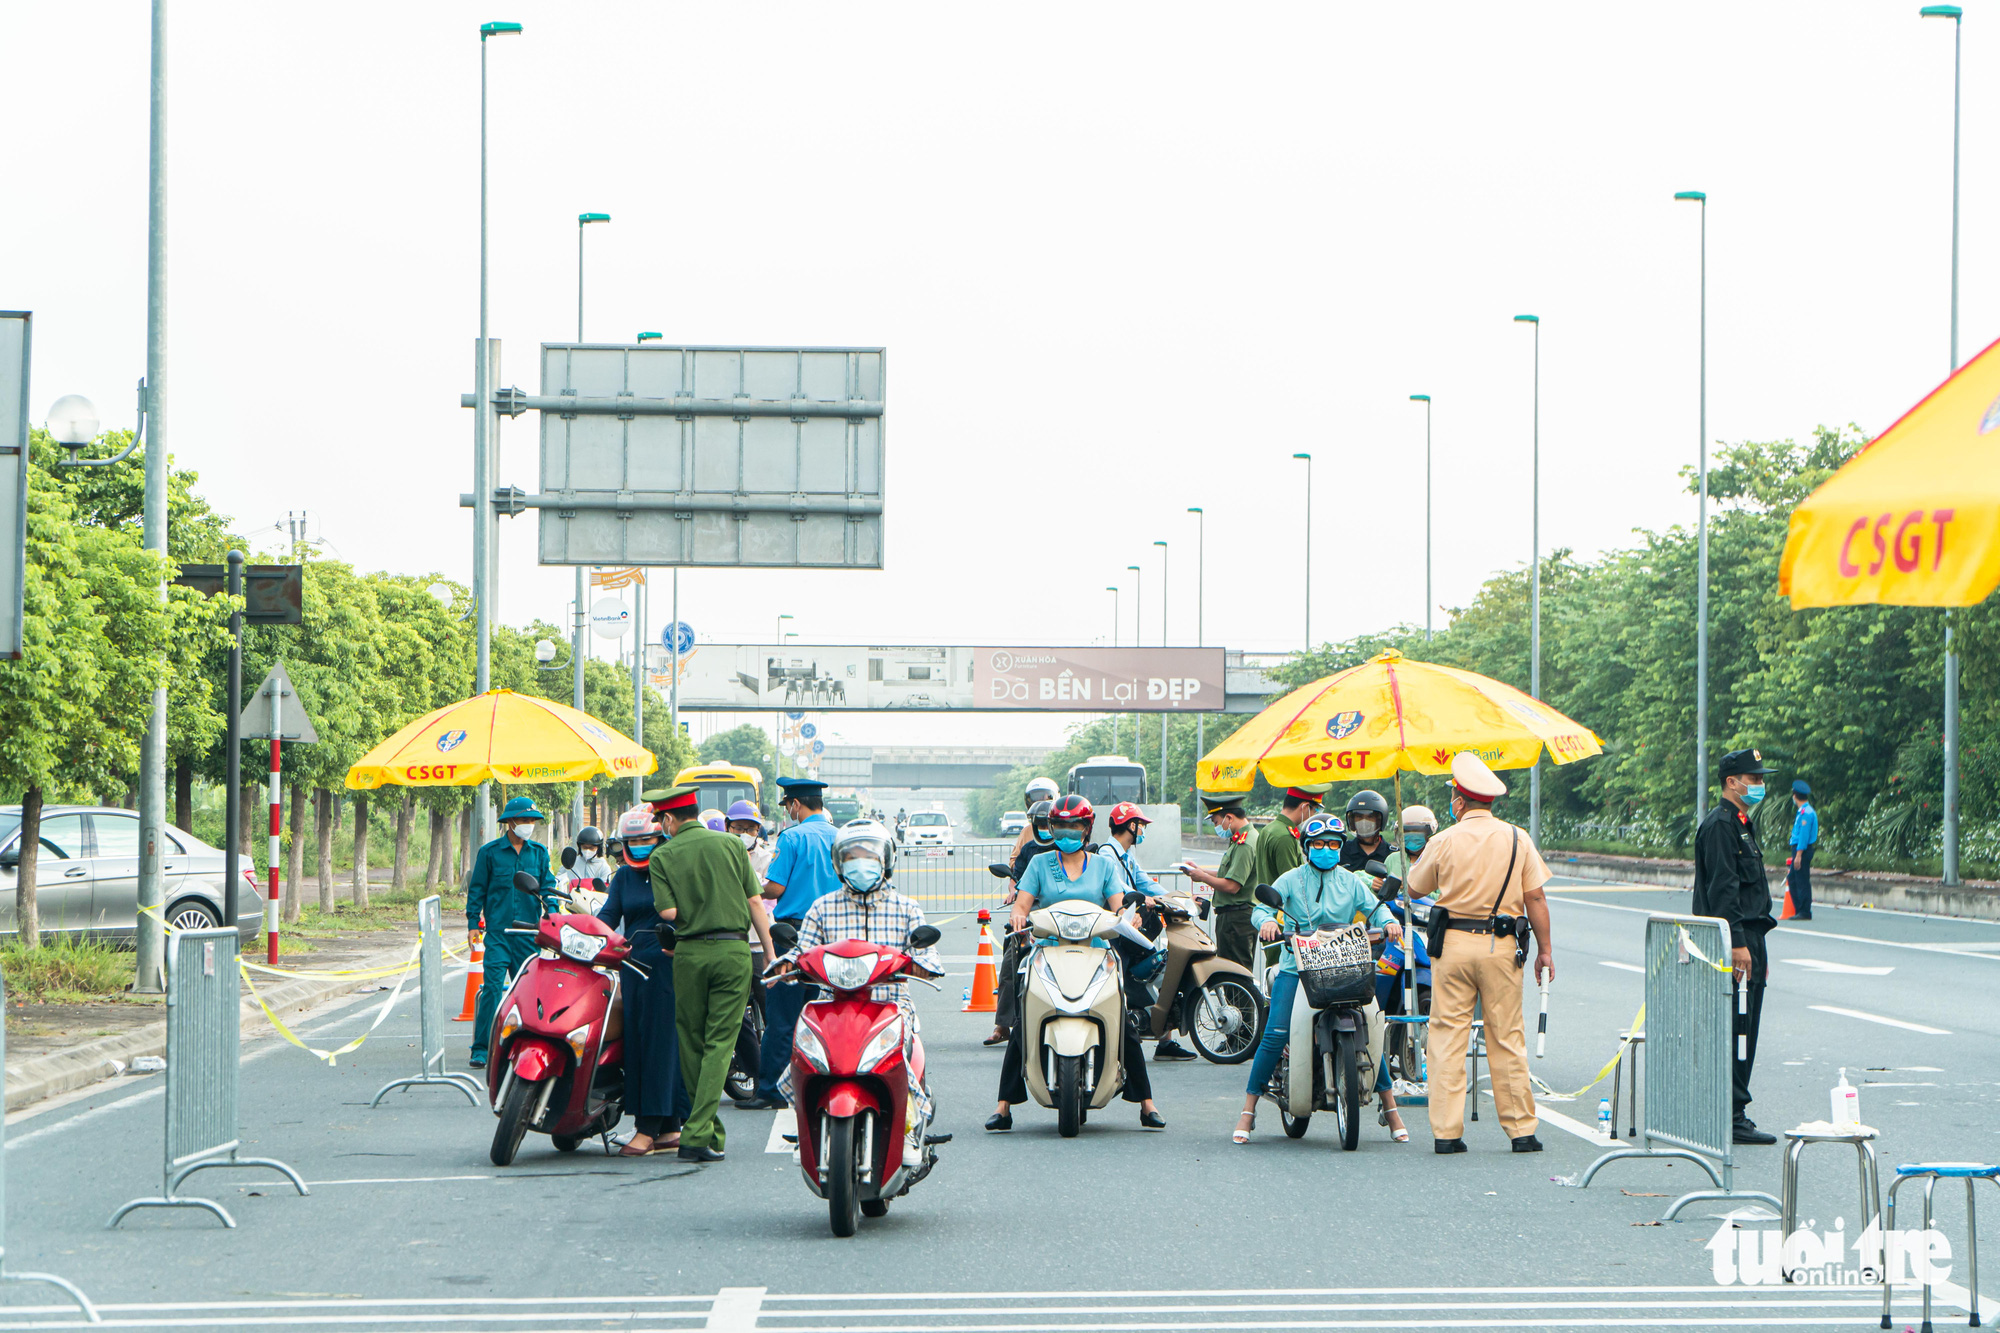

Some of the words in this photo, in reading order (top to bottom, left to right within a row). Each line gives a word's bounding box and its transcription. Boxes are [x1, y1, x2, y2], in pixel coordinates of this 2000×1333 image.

[1838, 509, 1955, 578] CSGT
[1039, 655, 1057, 663] HÒA
[990, 678, 1029, 700] Đã
[1102, 678, 1137, 705] Lại
[1147, 678, 1201, 707] ĐẸP
[1554, 735, 1585, 753] CSGT
[1303, 750, 1371, 772] CSGT
[1453, 747, 1505, 761] Bank
[613, 755, 638, 771] CSGT
[406, 765, 457, 780] CSGT
[527, 767, 568, 778] VPBank
